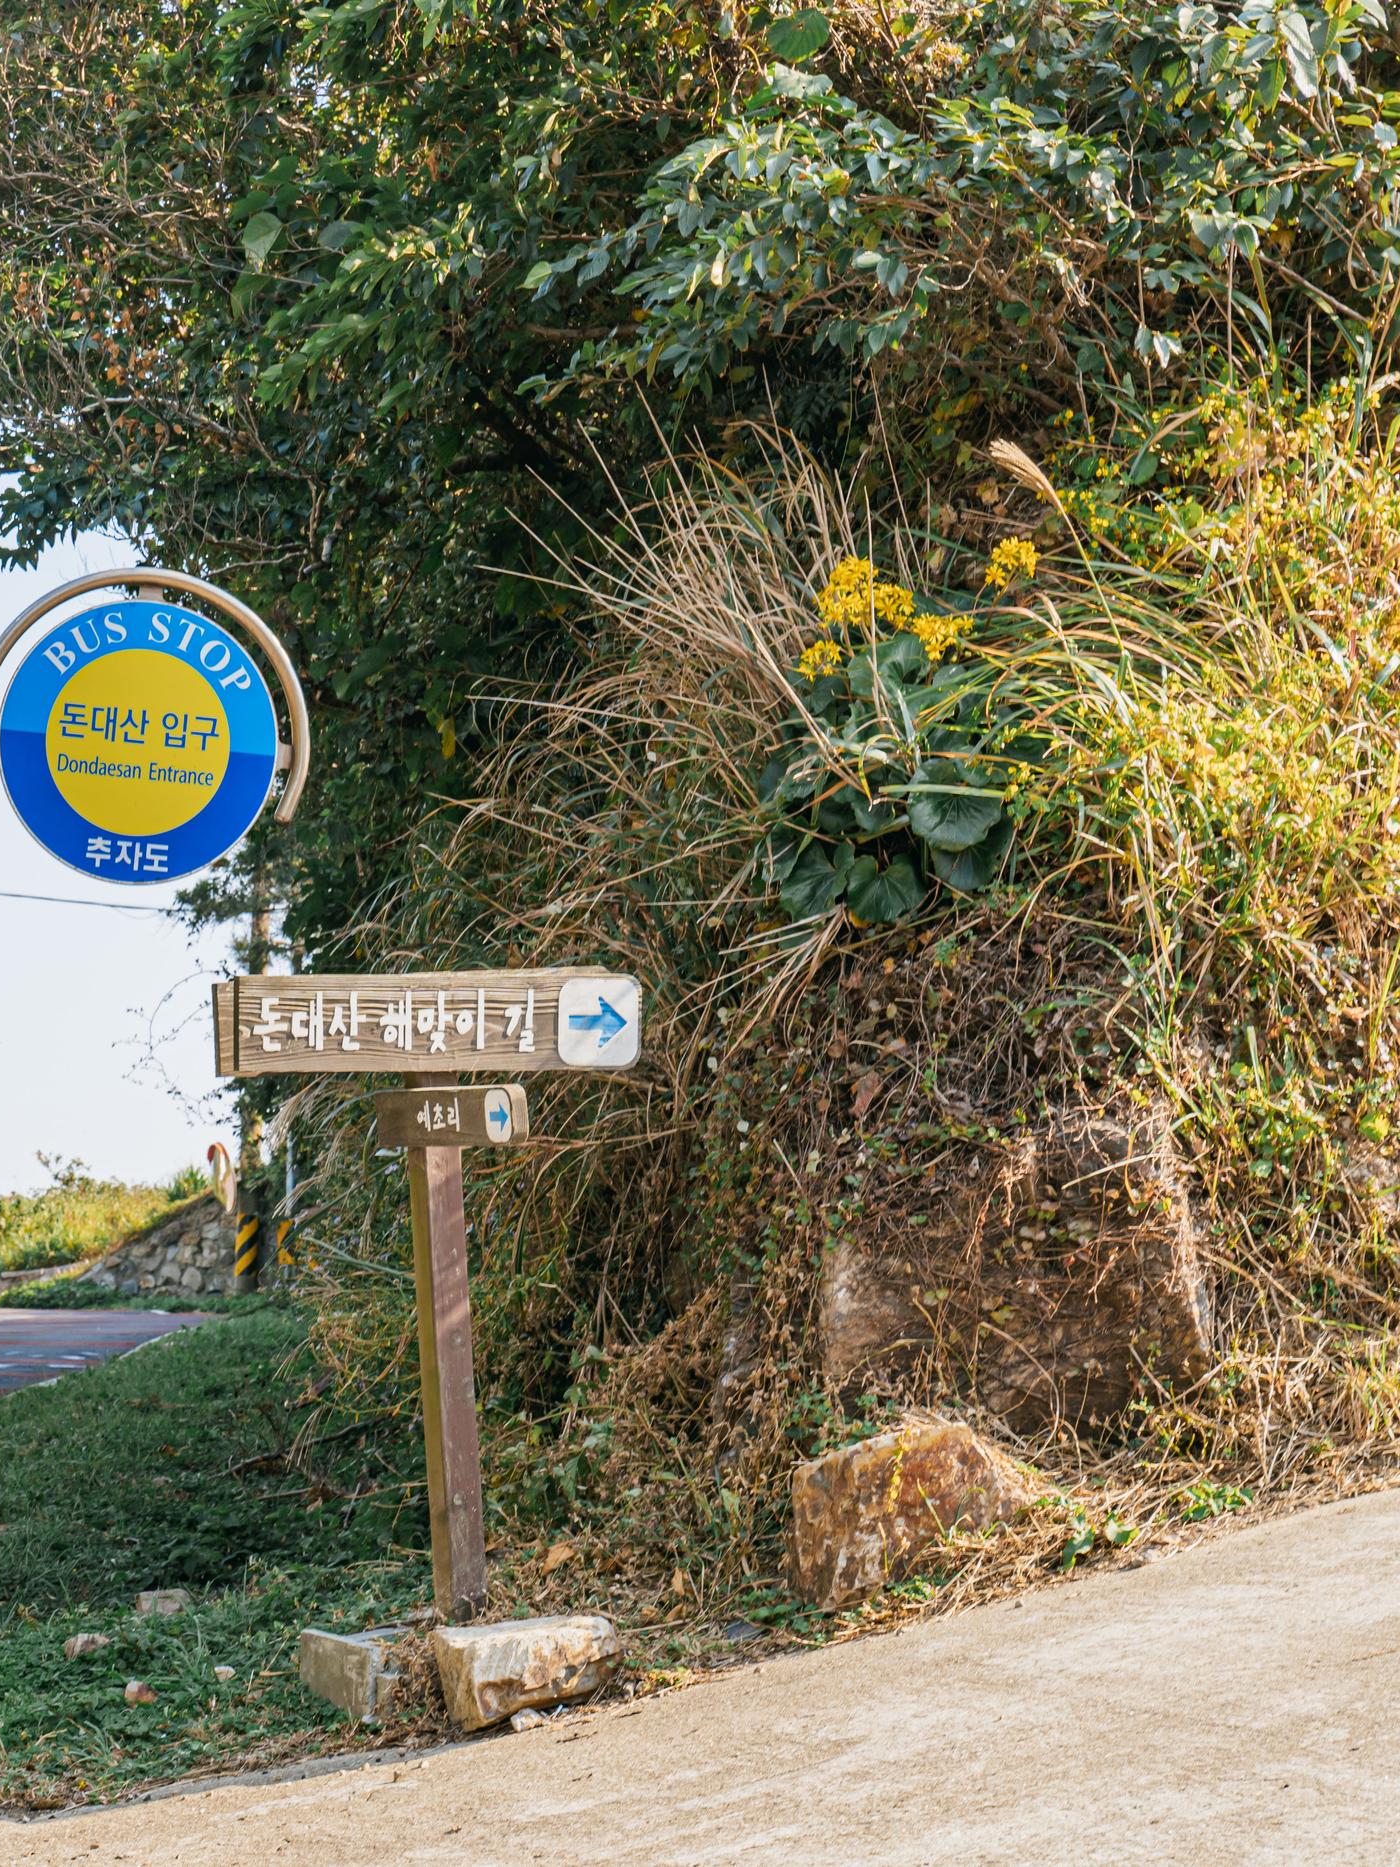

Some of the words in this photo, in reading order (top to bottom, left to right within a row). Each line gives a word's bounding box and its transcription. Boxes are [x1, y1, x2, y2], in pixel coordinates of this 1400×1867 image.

[42, 611, 128, 675] BUS
[147, 611, 252, 692] STOP
[58, 702, 150, 745] 돈대산
[161, 712, 220, 752] 입구
[56, 753, 142, 780] Dondaesan
[148, 761, 215, 787] Entrance
[85, 835, 170, 873] 추자도
[252, 990, 367, 1053] 돈대산
[378, 987, 486, 1055] 해맞이
[503, 987, 536, 1053] 길
[416, 1096, 461, 1132] 예초리
